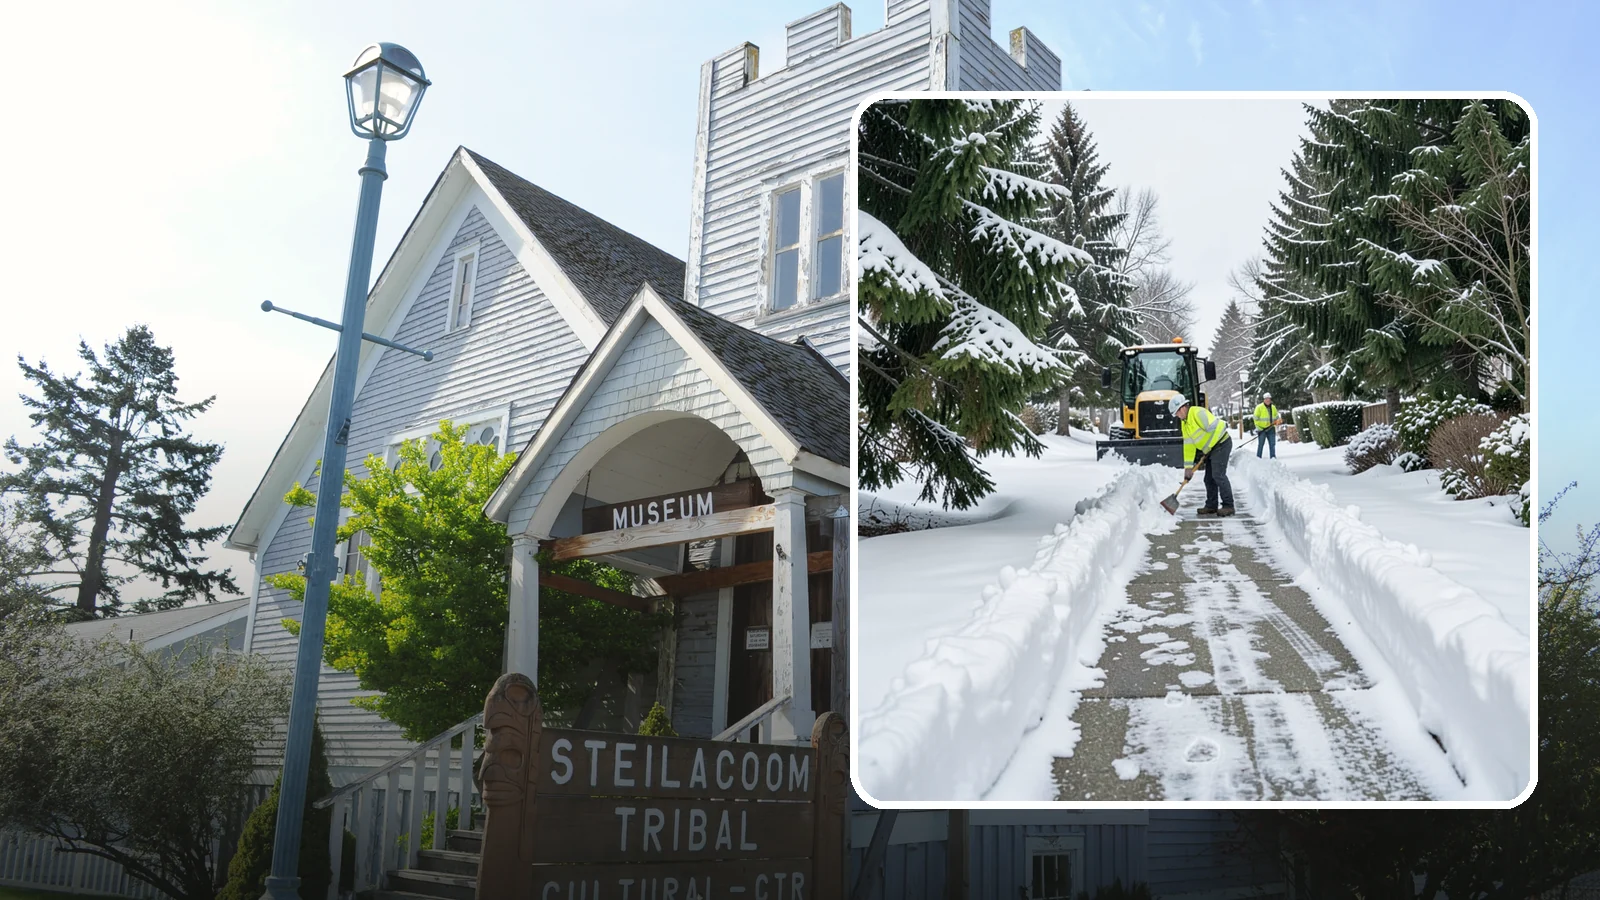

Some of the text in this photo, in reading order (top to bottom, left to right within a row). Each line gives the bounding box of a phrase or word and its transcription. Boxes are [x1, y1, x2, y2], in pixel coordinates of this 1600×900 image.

[613, 491, 714, 531] MUSEUM
[550, 738, 810, 793] STEILACOOM
[615, 806, 758, 852] TRIBAL
